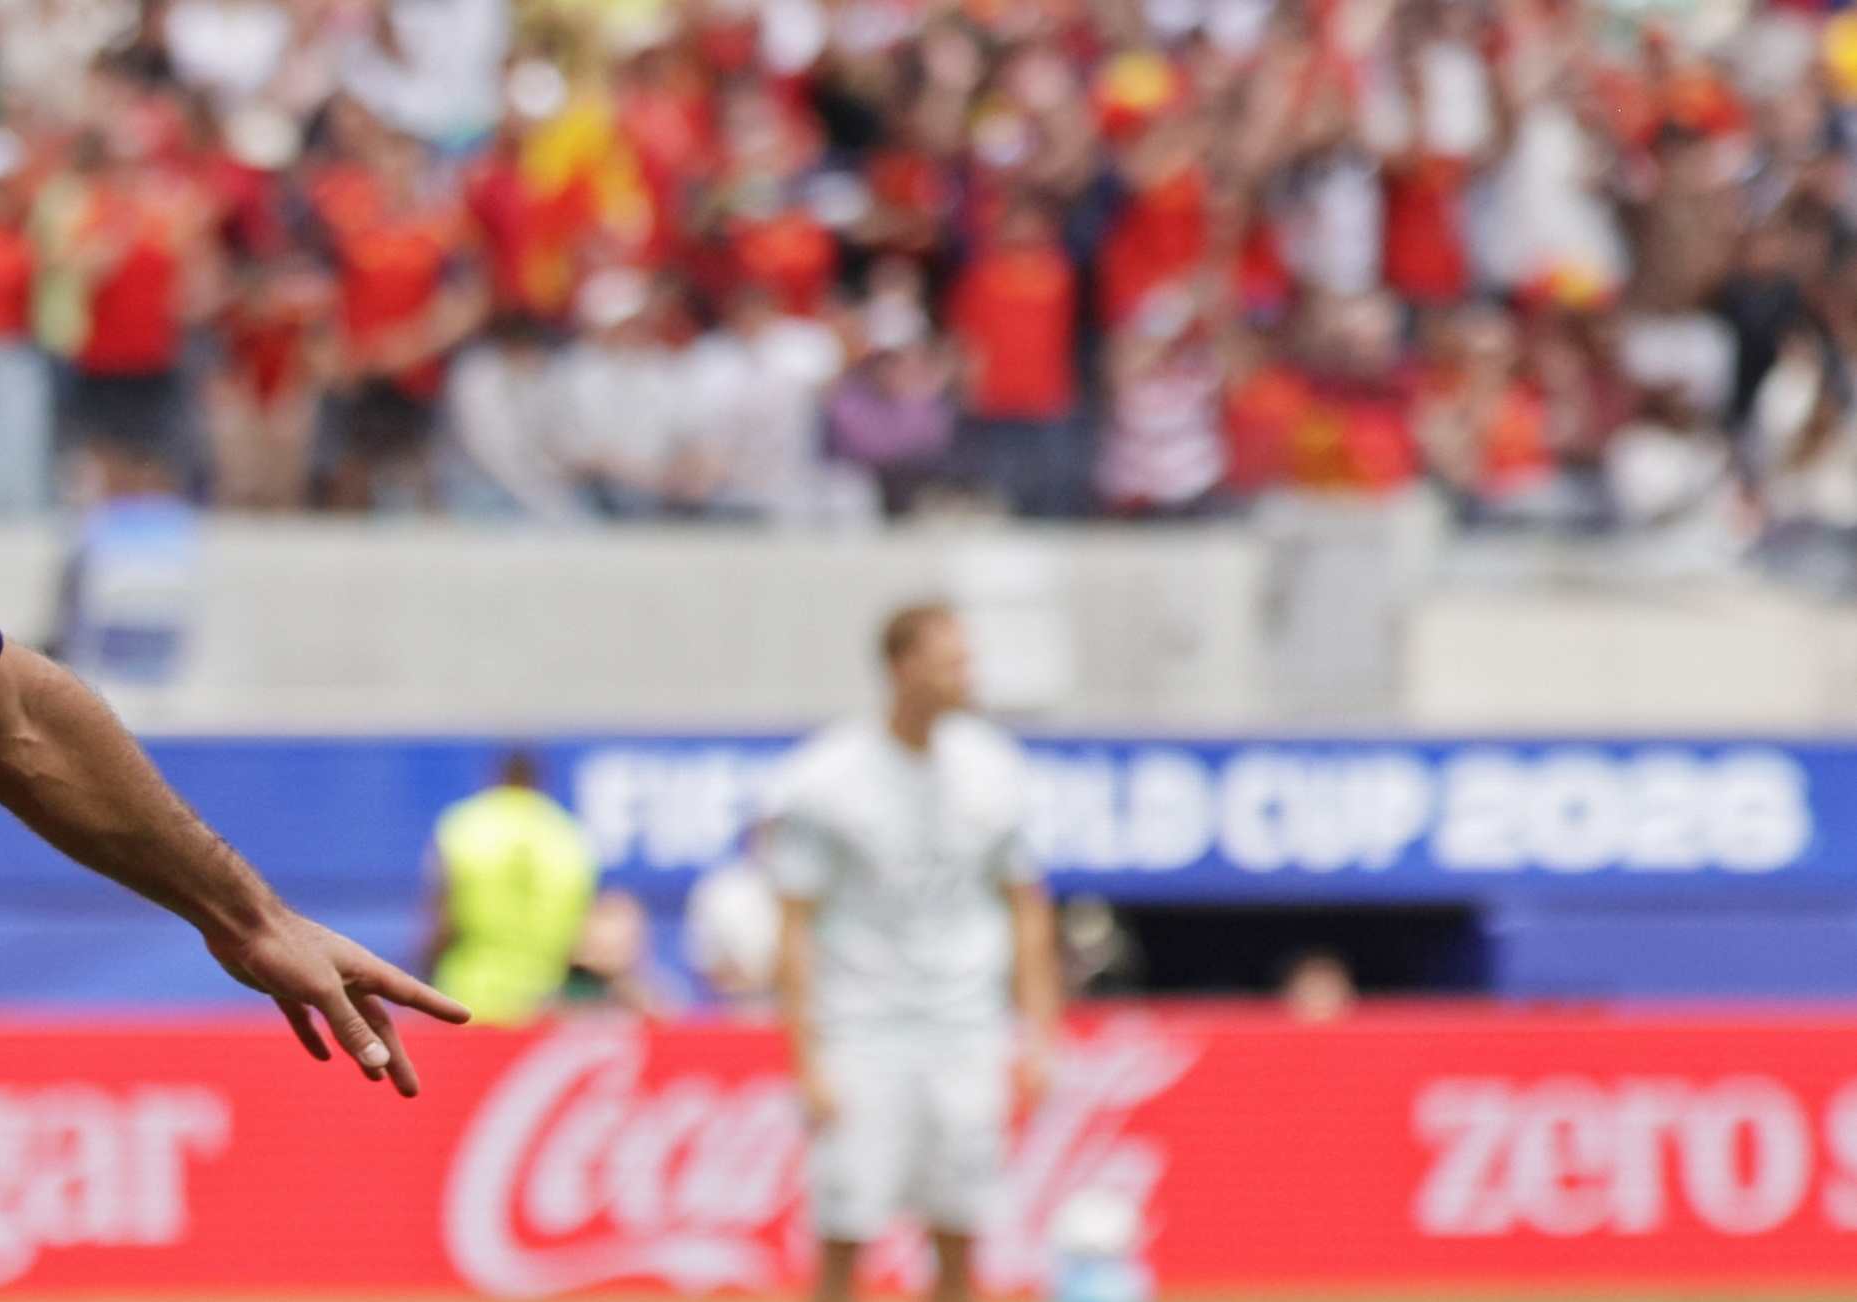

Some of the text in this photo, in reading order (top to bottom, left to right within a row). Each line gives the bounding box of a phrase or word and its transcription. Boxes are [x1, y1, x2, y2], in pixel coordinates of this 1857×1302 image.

[1219, 748, 1431, 872] CUP
[1433, 748, 1813, 872] 2026
[1409, 1075, 1813, 1236] zero
